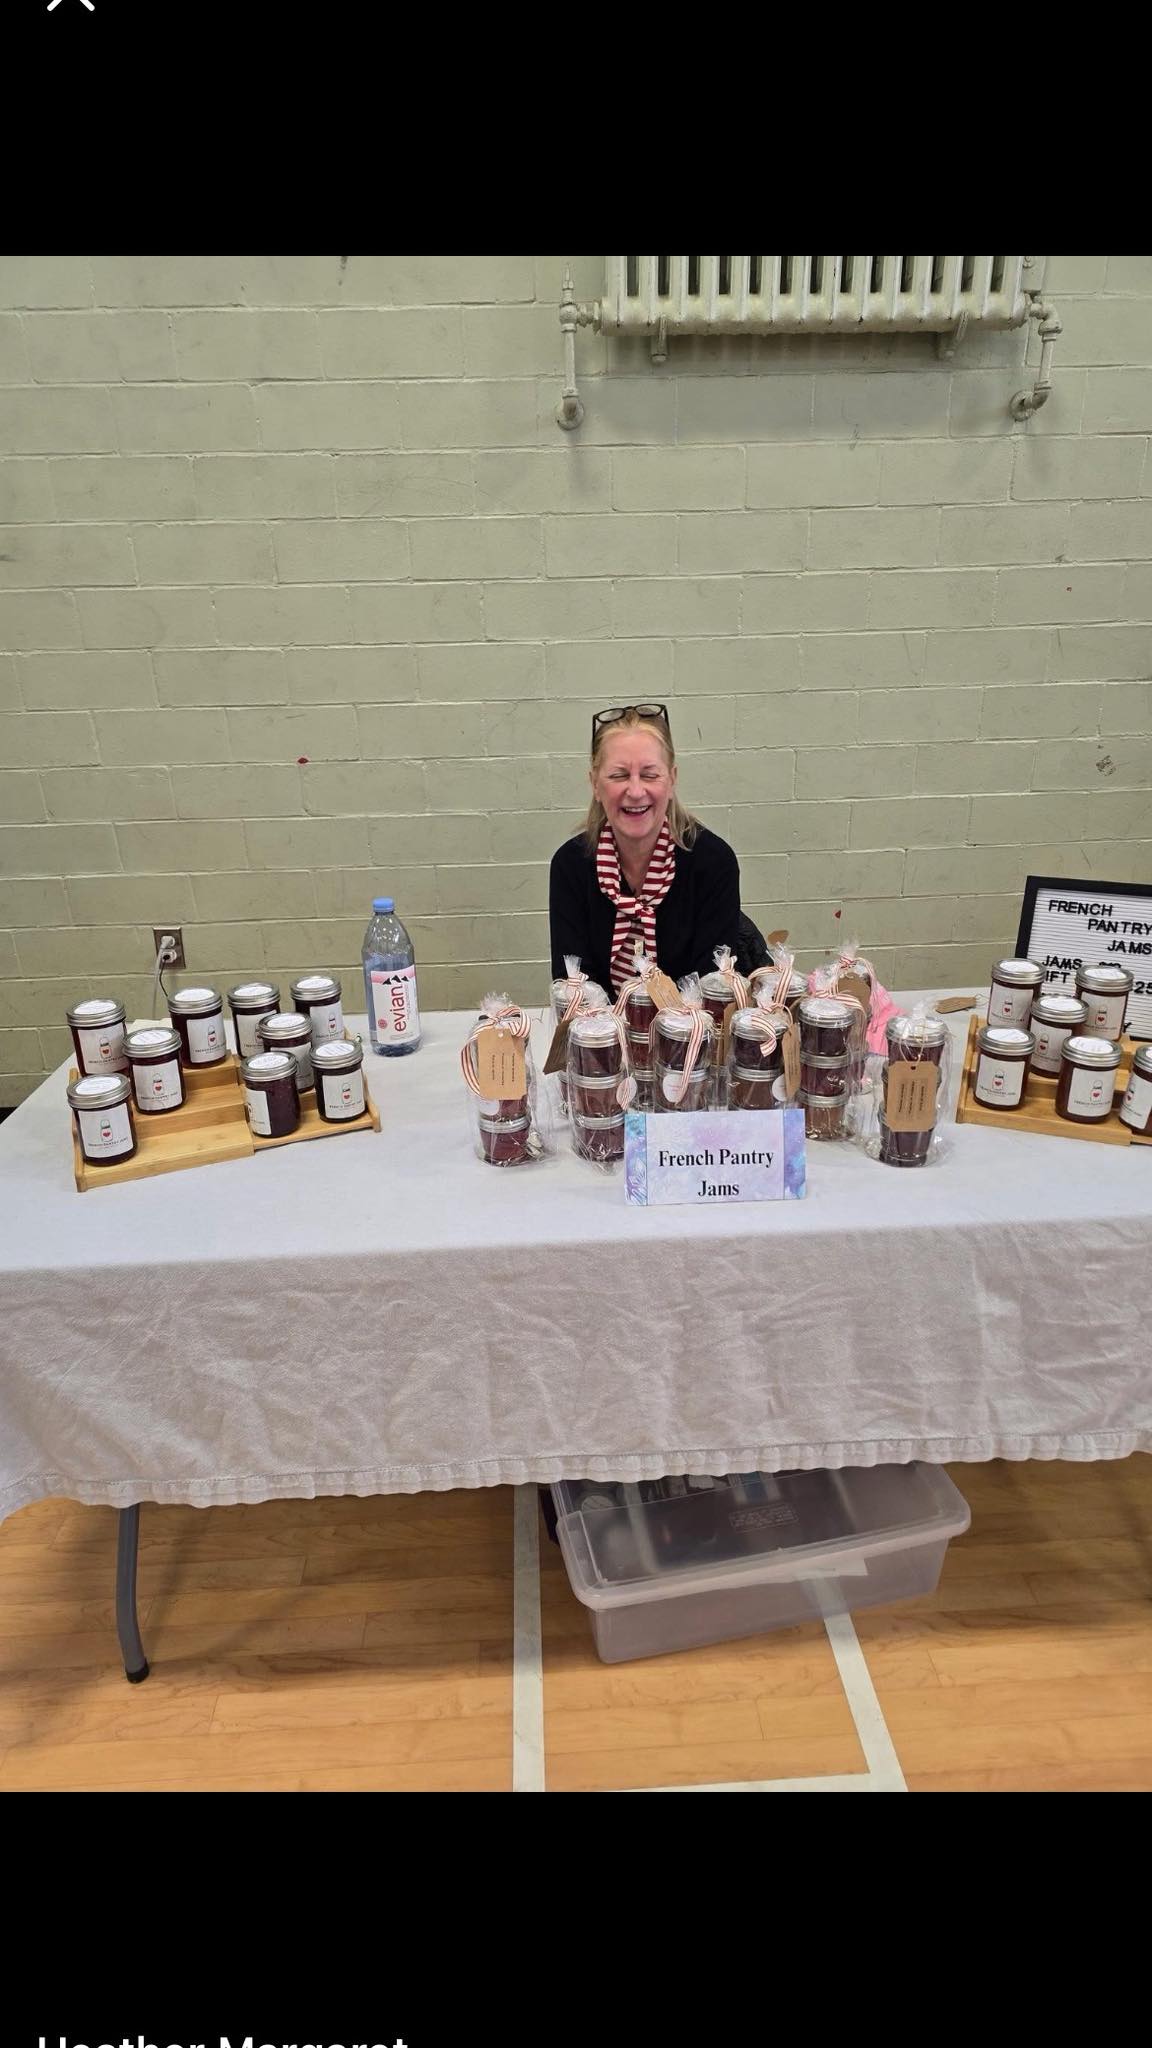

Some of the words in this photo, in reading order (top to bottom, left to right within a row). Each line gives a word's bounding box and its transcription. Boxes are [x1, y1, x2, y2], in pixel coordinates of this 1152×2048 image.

[1048, 900, 1113, 916] FRENCH
[1087, 918, 1152, 935] PANTRY
[1107, 940, 1152, 955] JAMS
[1042, 955, 1083, 970] JAMS
[1045, 971, 1070, 983] IFT
[390, 985, 407, 1032] evian
[658, 1149, 714, 1167] French
[719, 1148, 774, 1168] Pantry
[697, 1180, 740, 1197] Jams
